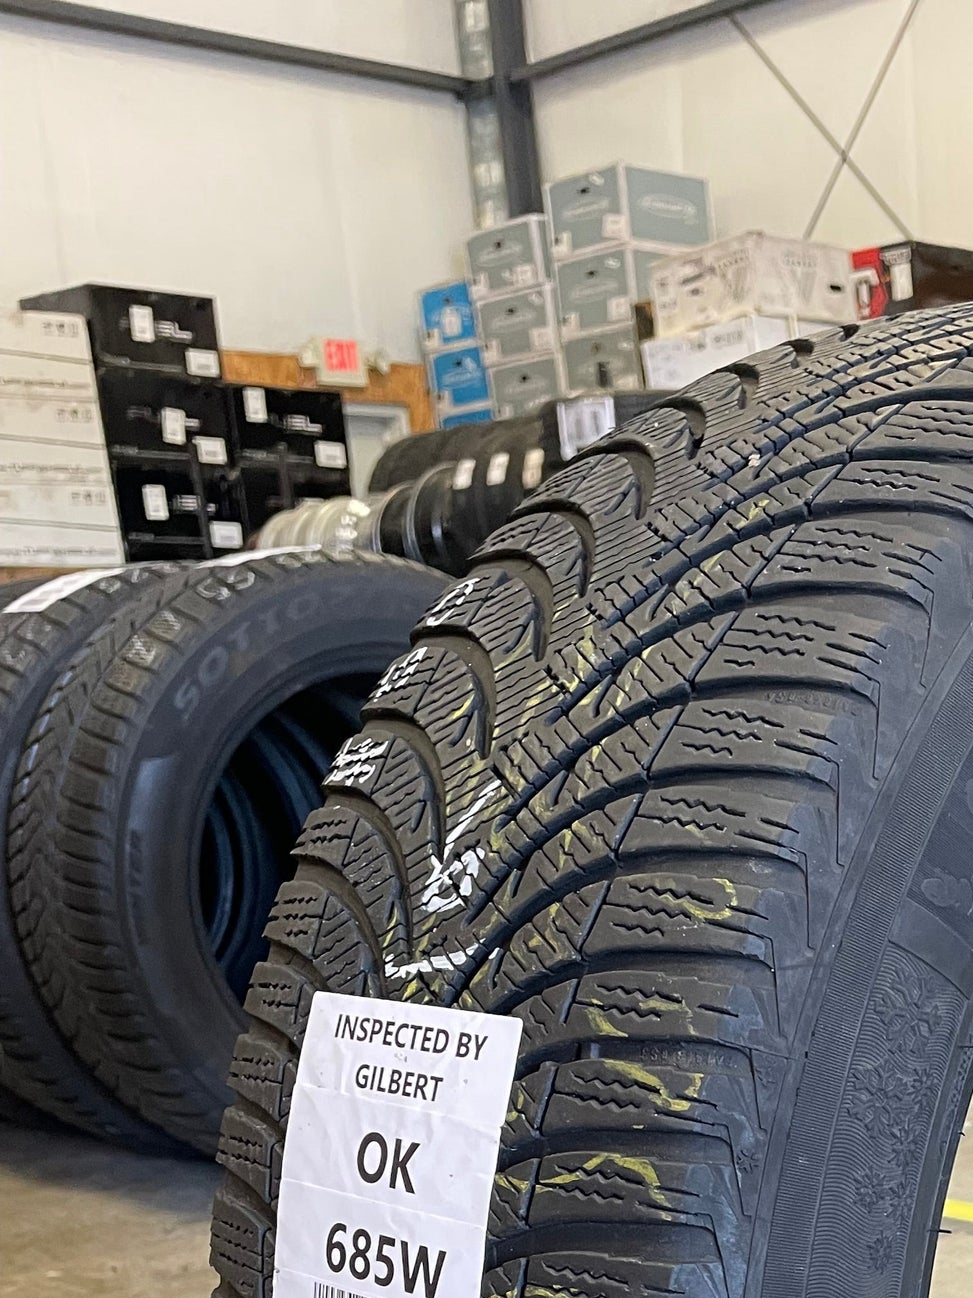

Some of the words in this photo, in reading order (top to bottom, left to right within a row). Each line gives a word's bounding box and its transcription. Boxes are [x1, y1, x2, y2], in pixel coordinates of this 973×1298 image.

[324, 339, 359, 373] EXIT
[334, 1013, 450, 1055] INSPECTED
[455, 1031, 489, 1061] BY
[354, 1063, 444, 1102] GILBERT
[356, 1131, 421, 1194] OK
